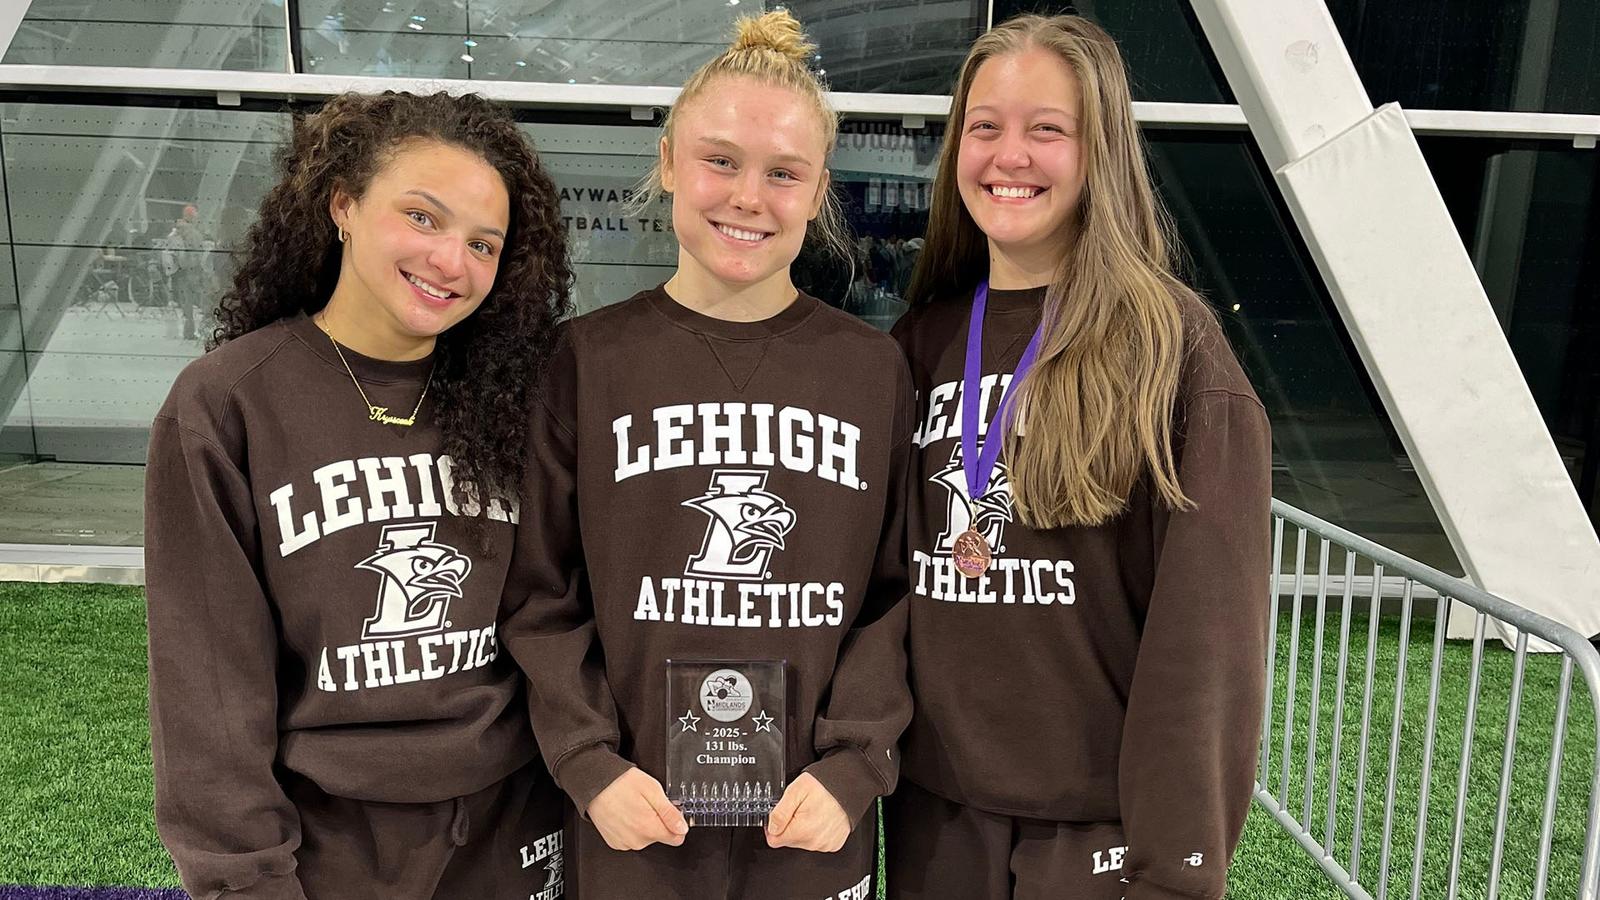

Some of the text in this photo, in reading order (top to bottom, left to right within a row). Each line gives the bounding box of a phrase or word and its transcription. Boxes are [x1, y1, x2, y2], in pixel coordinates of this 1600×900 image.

[612, 402, 861, 490] LEHIGH
[913, 550, 1076, 606] THLETICS
[633, 576, 845, 628] ATHLETICS
[705, 741, 748, 751] 131 lbs.
[712, 727, 740, 738] 2025
[696, 754, 756, 766] Champion
[520, 829, 564, 869] LEHI
